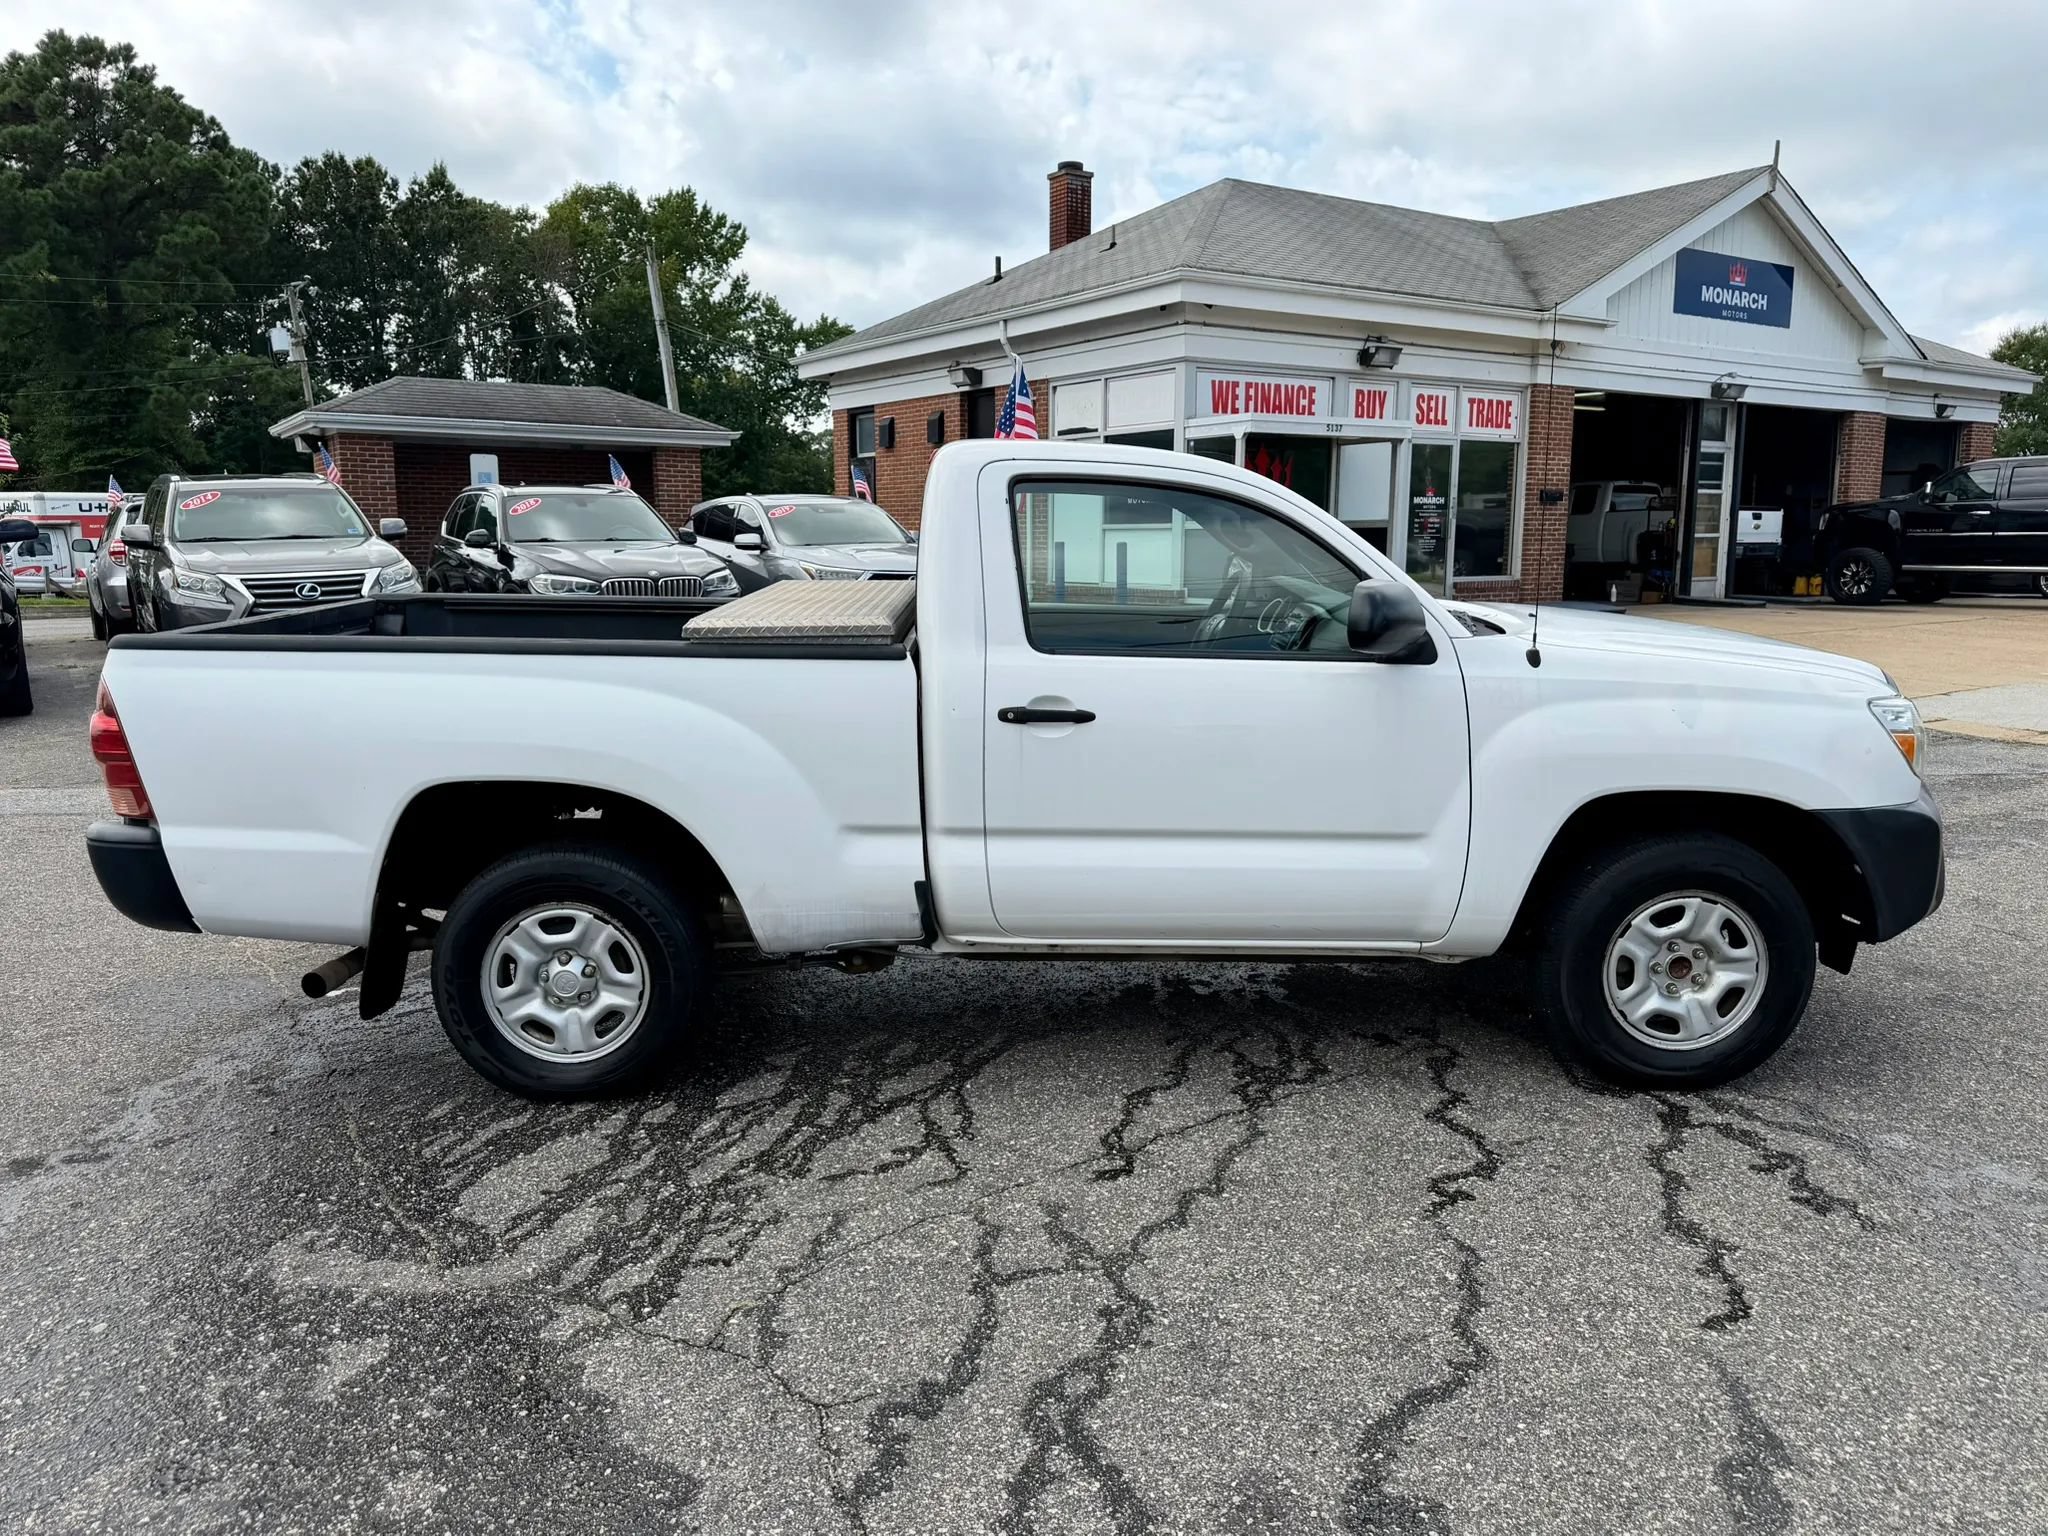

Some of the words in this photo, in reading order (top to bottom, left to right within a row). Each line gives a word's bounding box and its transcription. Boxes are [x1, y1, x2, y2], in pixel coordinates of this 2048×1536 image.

[1701, 285, 1768, 311] MONARCH
[1722, 309, 1748, 320] MOTORS
[1211, 379, 1240, 415] WE
[1244, 381, 1316, 417] FINANCE
[1354, 388, 1388, 420] BUY
[1415, 392, 1448, 426] SELL
[1467, 397, 1513, 430] TRADE
[1326, 423, 1343, 432] 5137
[187, 492, 213, 508] 2014
[1413, 496, 1445, 504] MONARCH
